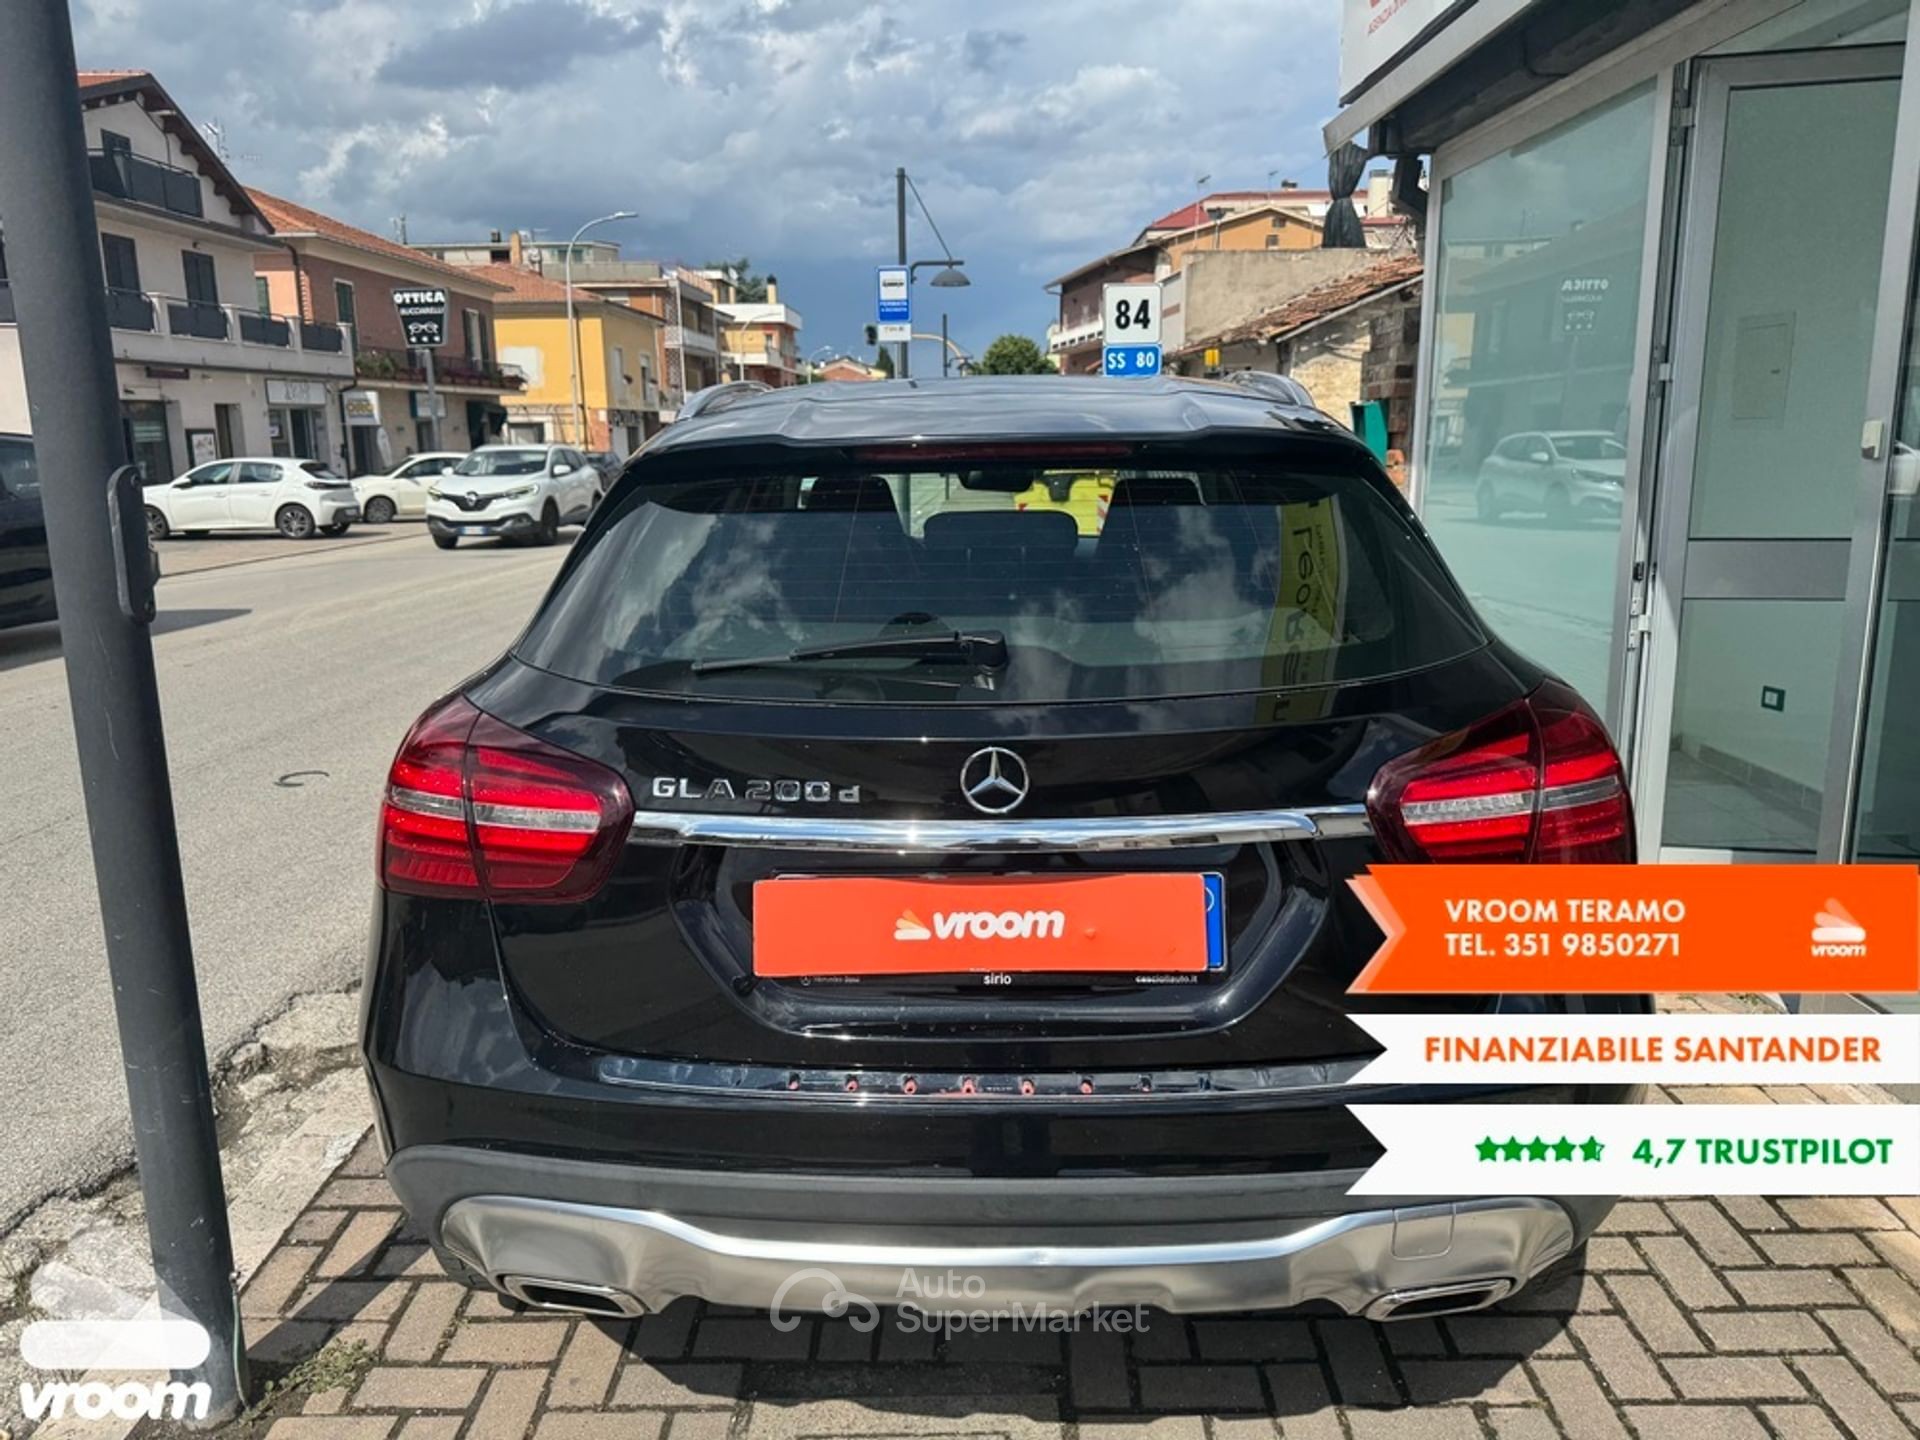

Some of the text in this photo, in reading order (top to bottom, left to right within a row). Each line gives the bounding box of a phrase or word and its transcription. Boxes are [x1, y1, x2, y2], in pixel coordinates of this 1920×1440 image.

[393, 291, 445, 304] OTTICA
[1115, 298, 1151, 330] 84
[1107, 351, 1156, 370] SS 80
[652, 777, 736, 799] GLA
[744, 780, 831, 802] 200
[933, 910, 1066, 940] vroom
[983, 972, 1012, 985] sirio
